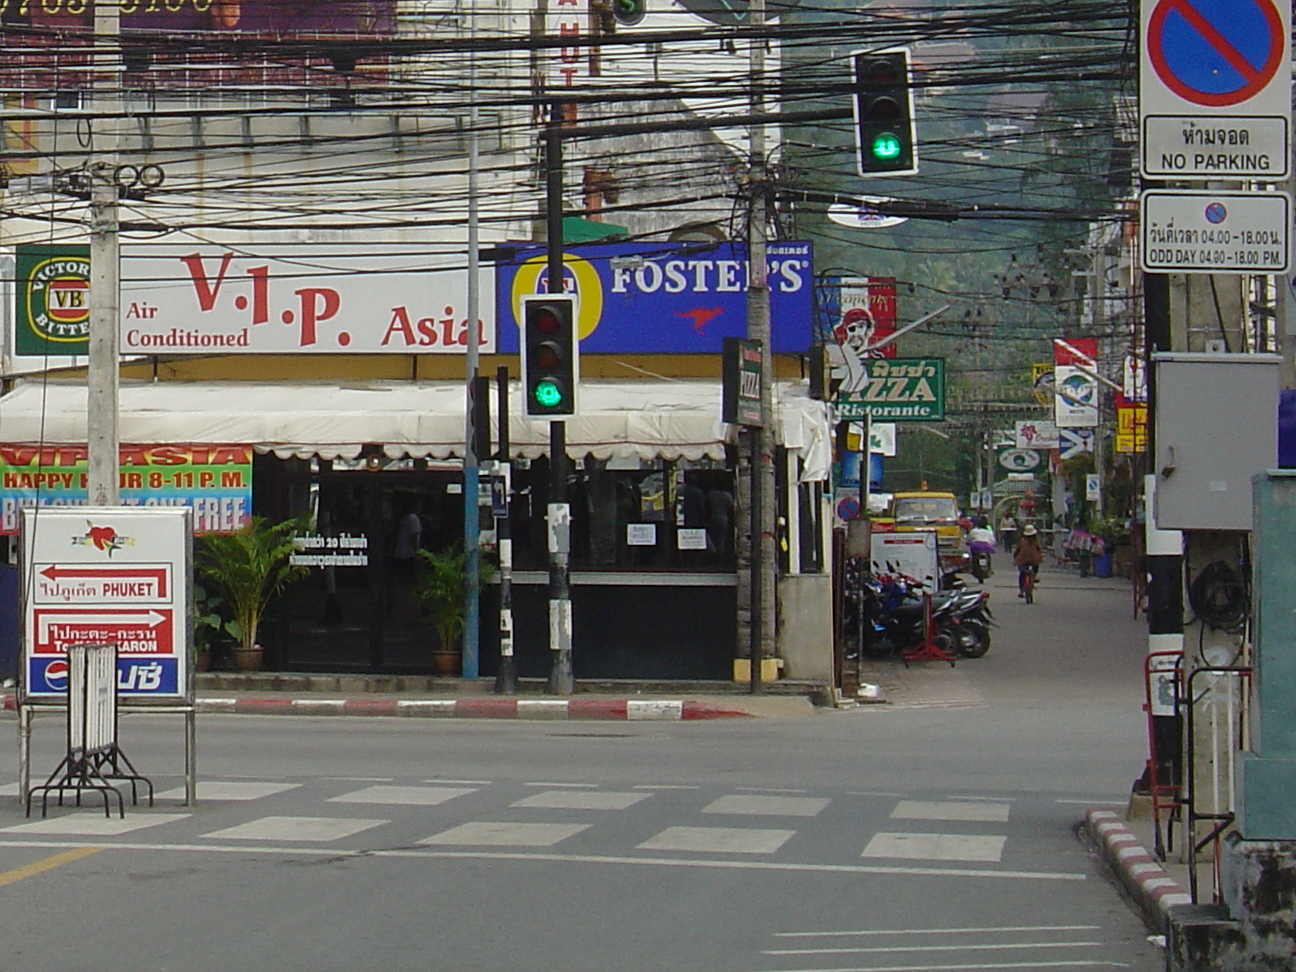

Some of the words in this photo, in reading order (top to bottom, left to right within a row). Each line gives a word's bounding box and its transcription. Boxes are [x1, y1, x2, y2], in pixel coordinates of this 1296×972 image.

[1182, 122, 1250, 146] ห้ามจอด
[1161, 153, 1187, 170] NO
[1193, 153, 1271, 171] PARKING
[1149, 248, 1173, 264] ODD
[1175, 248, 1197, 263] DAY
[32, 262, 91, 292] VICTOR
[55, 289, 83, 309] VB
[126, 302, 158, 320] Air
[36, 313, 90, 336] BITTE
[380, 306, 489, 346] Asia
[126, 328, 250, 348] Conditioned
[838, 404, 931, 417] Ristorante
[119, 447, 250, 466] ASIA
[4, 473, 76, 489] HAPPY
[148, 471, 193, 488] 8-11
[193, 497, 245, 531] FREE
[326, 538, 338, 547] 20
[103, 583, 153, 596] PHUKET
